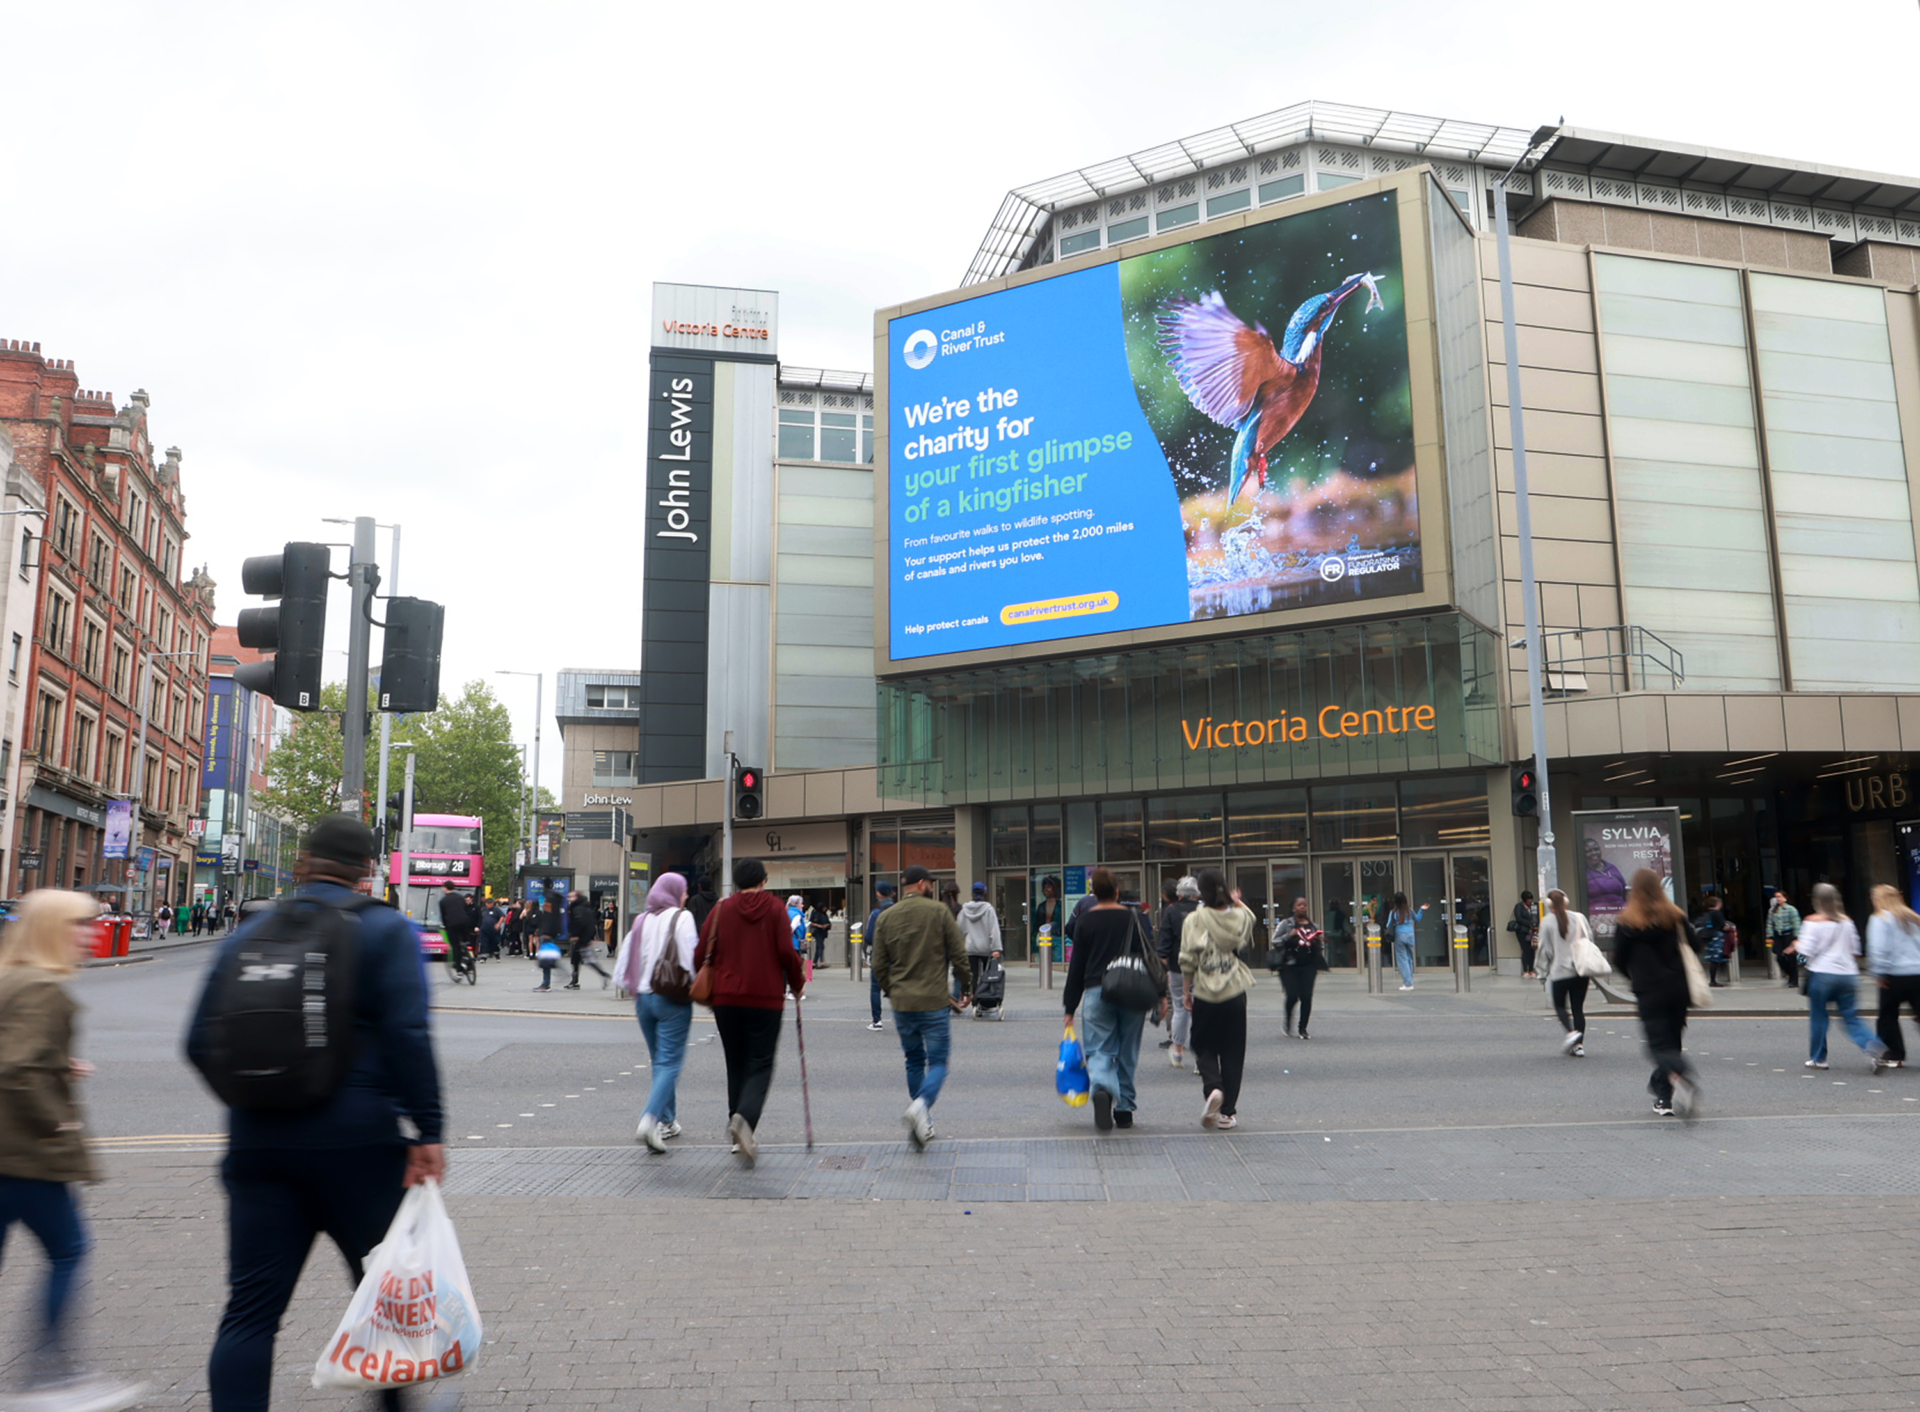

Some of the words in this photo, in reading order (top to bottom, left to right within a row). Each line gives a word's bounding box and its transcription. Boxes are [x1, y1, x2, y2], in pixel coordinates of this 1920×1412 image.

[663, 319, 719, 336] Victoria
[722, 323, 769, 340] Centre
[941, 323, 975, 342] Canal
[977, 321, 986, 333] &
[941, 340, 972, 356] River
[973, 331, 1005, 348] Trust
[658, 377, 694, 461] Lewis
[904, 396, 971, 428] We're
[976, 388, 1019, 414] the
[904, 425, 989, 460] charity
[996, 416, 1034, 441] for
[905, 463, 961, 497] your
[968, 450, 1020, 479] first
[1027, 431, 1133, 473] glimpse
[656, 469, 698, 544] John
[905, 502, 930, 523] of
[937, 500, 951, 517] a
[958, 472, 1088, 512] kingfisher
[904, 536, 928, 549] From
[930, 528, 970, 544] favourite
[973, 523, 999, 537] walks
[1001, 520, 1012, 532] to
[1014, 513, 1048, 529] wildlife
[1051, 507, 1096, 525] spotting.
[904, 555, 926, 568] Your
[928, 548, 966, 565] support
[969, 543, 995, 558] helps
[998, 541, 1009, 552] us
[1012, 534, 1050, 553] protect
[1052, 530, 1070, 544] the
[1072, 524, 1103, 541] 2,000
[1106, 520, 1134, 535] miles
[904, 569, 915, 581] of
[917, 565, 947, 580] canals
[949, 561, 967, 575] and
[969, 558, 997, 572] rivers
[1000, 554, 1018, 569] you
[1021, 551, 1045, 563] love.
[1348, 555, 1400, 569] FUNDRAISING
[1348, 562, 1400, 576] REGULATOR
[1008, 595, 1109, 619] canalrivertrust.org.uk
[905, 624, 925, 636] Help
[927, 618, 959, 633] protect
[962, 614, 989, 627] canals
[210, 725, 219, 736] big
[1181, 709, 1308, 750] Victoria
[1318, 704, 1435, 738] Centre
[207, 761, 217, 772] big
[583, 793, 609, 807] John
[1602, 826, 1661, 840] SYLVIA
[452, 861, 464, 872] 28
[1633, 850, 1663, 859] REST.
[594, 880, 609, 888] John
[329, 1332, 464, 1382] Iceland
